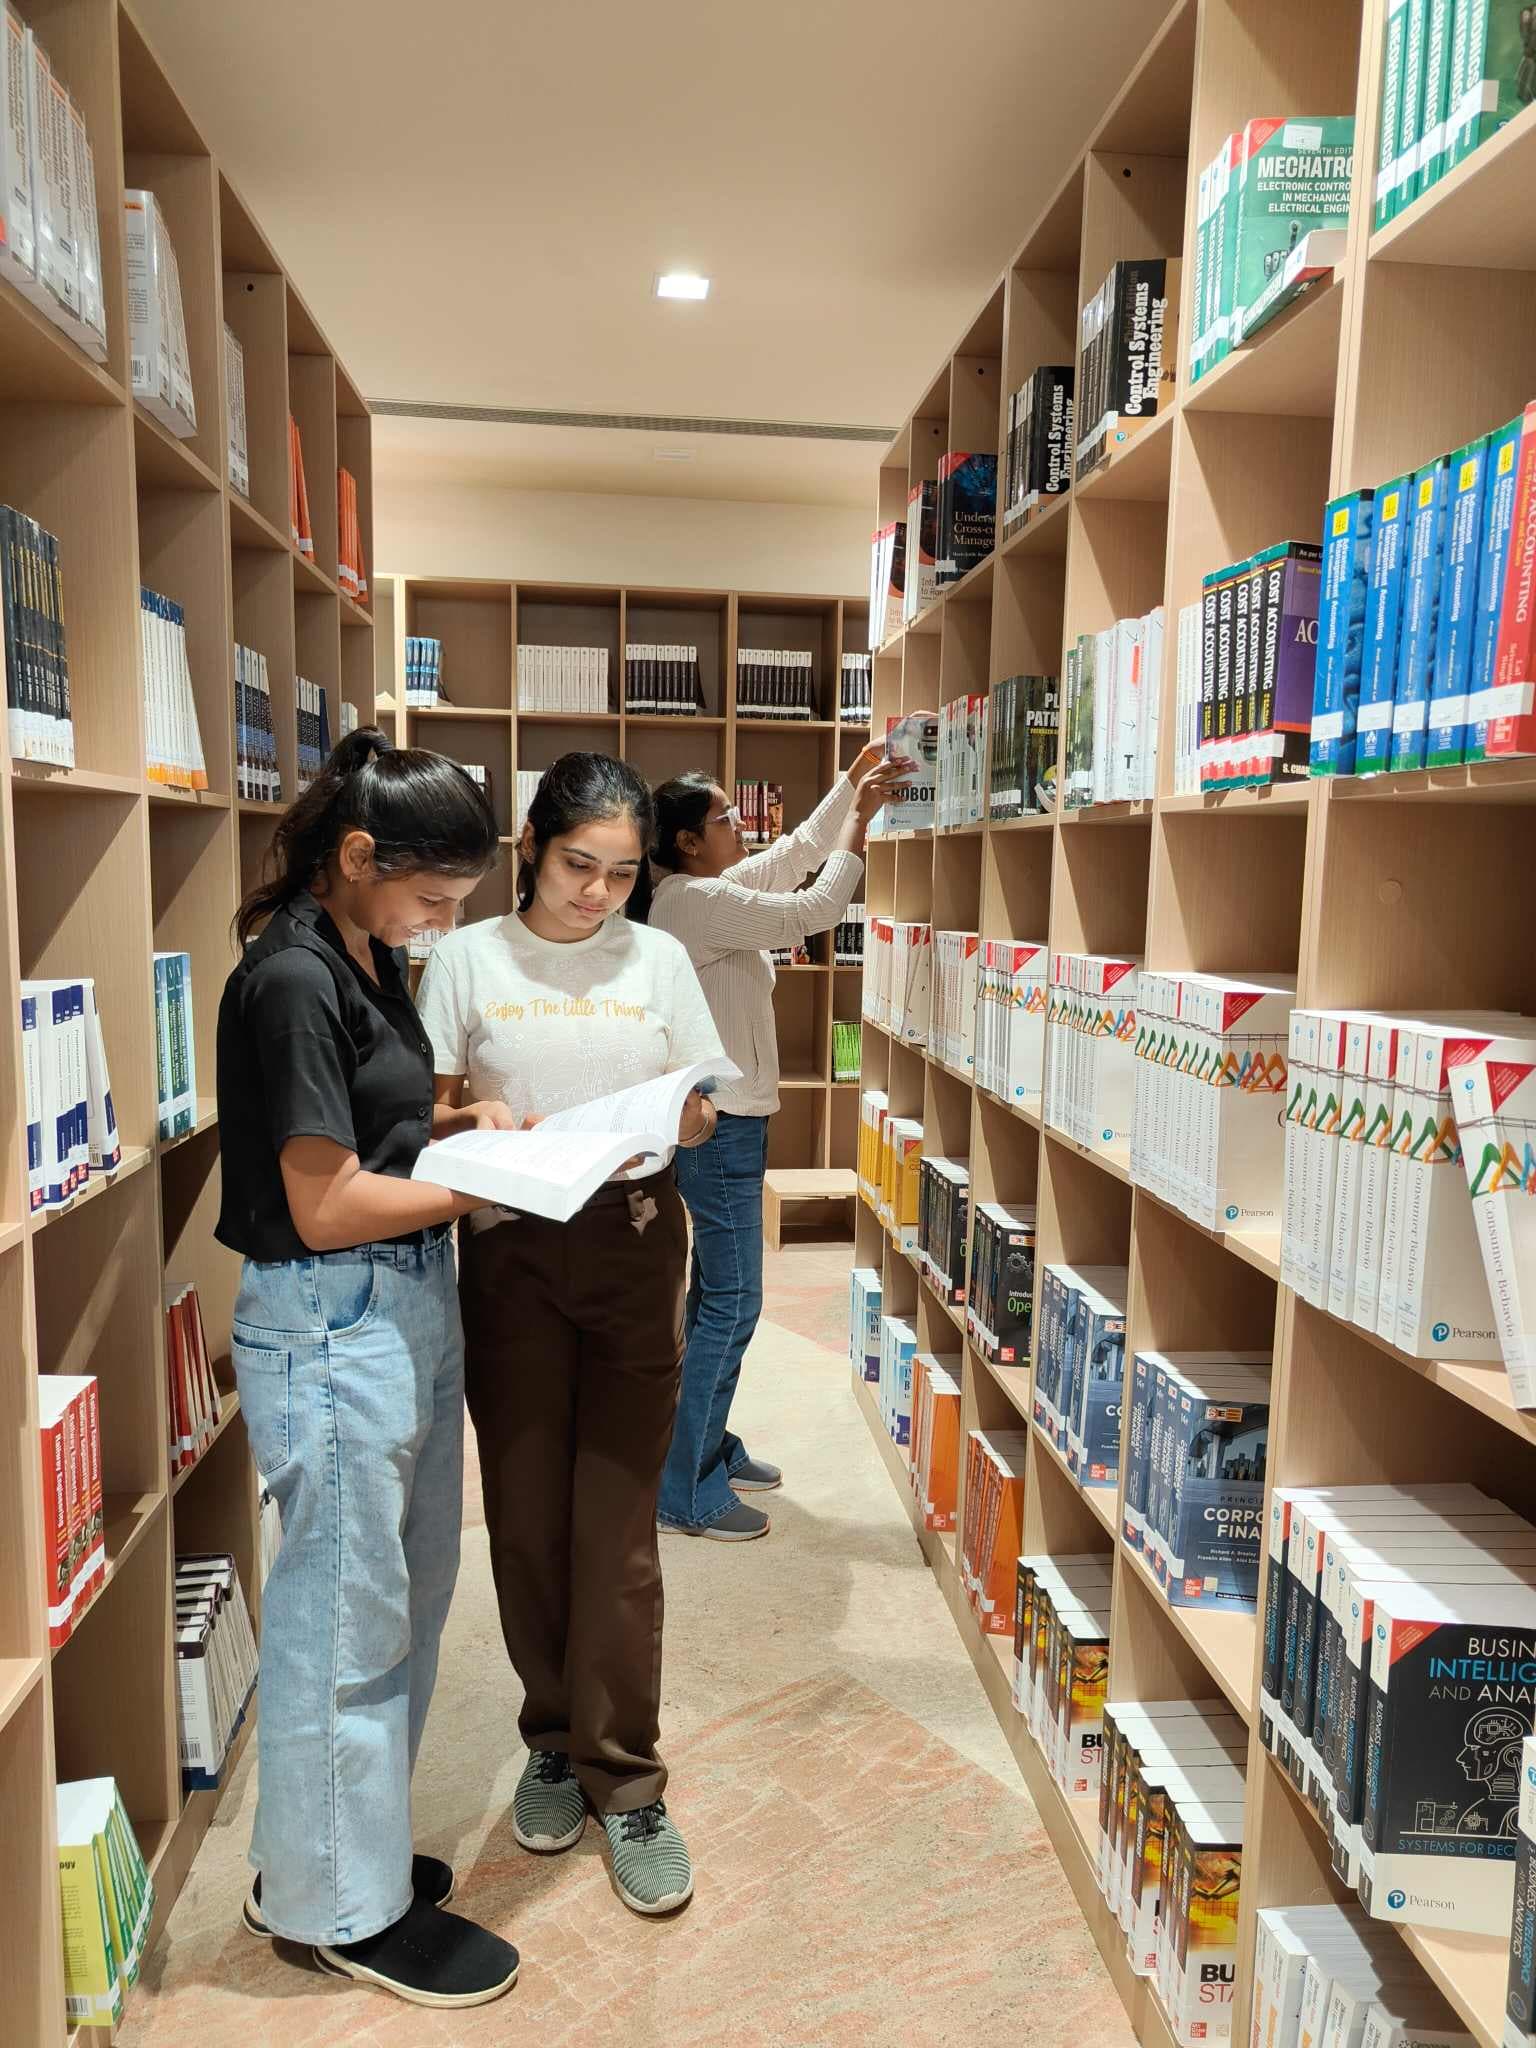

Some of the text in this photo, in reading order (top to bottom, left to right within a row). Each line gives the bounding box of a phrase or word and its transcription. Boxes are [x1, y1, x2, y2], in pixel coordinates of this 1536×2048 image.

[1257, 181, 1312, 192] ELECTRONIC
[1282, 193, 1292, 202] IN
[1268, 203, 1321, 213] ELECTRICAL
[1124, 281, 1150, 415] Control Systems
[1142, 297, 1168, 400] Engineering
[1046, 384, 1064, 492] Control Systems
[1237, 583, 1248, 615] COST
[1252, 577, 1262, 610] COST
[1268, 571, 1281, 604] COST
[1204, 594, 1216, 625] COST
[1220, 590, 1232, 622] COST
[1203, 627, 1216, 702] ACCOUNTING
[1218, 624, 1230, 700] ACCOUNTING
[1234, 618, 1248, 697] ACCOUNTING
[1248, 613, 1260, 693] ACCOUNTING
[1262, 607, 1278, 690] ACCOUNTING
[484, 1001, 524, 1022] Enjoy
[528, 998, 560, 1017] The
[563, 997, 597, 1017] Little
[1368, 1152, 1377, 1218] Consumer
[1240, 1208, 1274, 1217] Pearson
[1410, 1167, 1424, 1237] Consumer
[1484, 1200, 1503, 1273] Consumer
[1452, 1326, 1496, 1340] Pearson
[56, 1472, 64, 1528] Engineering
[1216, 1524, 1260, 1540] FINA
[1468, 1637, 1536, 1658] BUSIN
[1428, 1657, 1536, 1684] INTELLIG
[1428, 1684, 1536, 1704] AND ANA
[1370, 1700, 1384, 1810] BUSINESS INTELLIGENCE
[1398, 1840, 1456, 1853] SYSTEMS
[1460, 1842, 1485, 1854] FOR
[1409, 1895, 1456, 1912] Pearson
